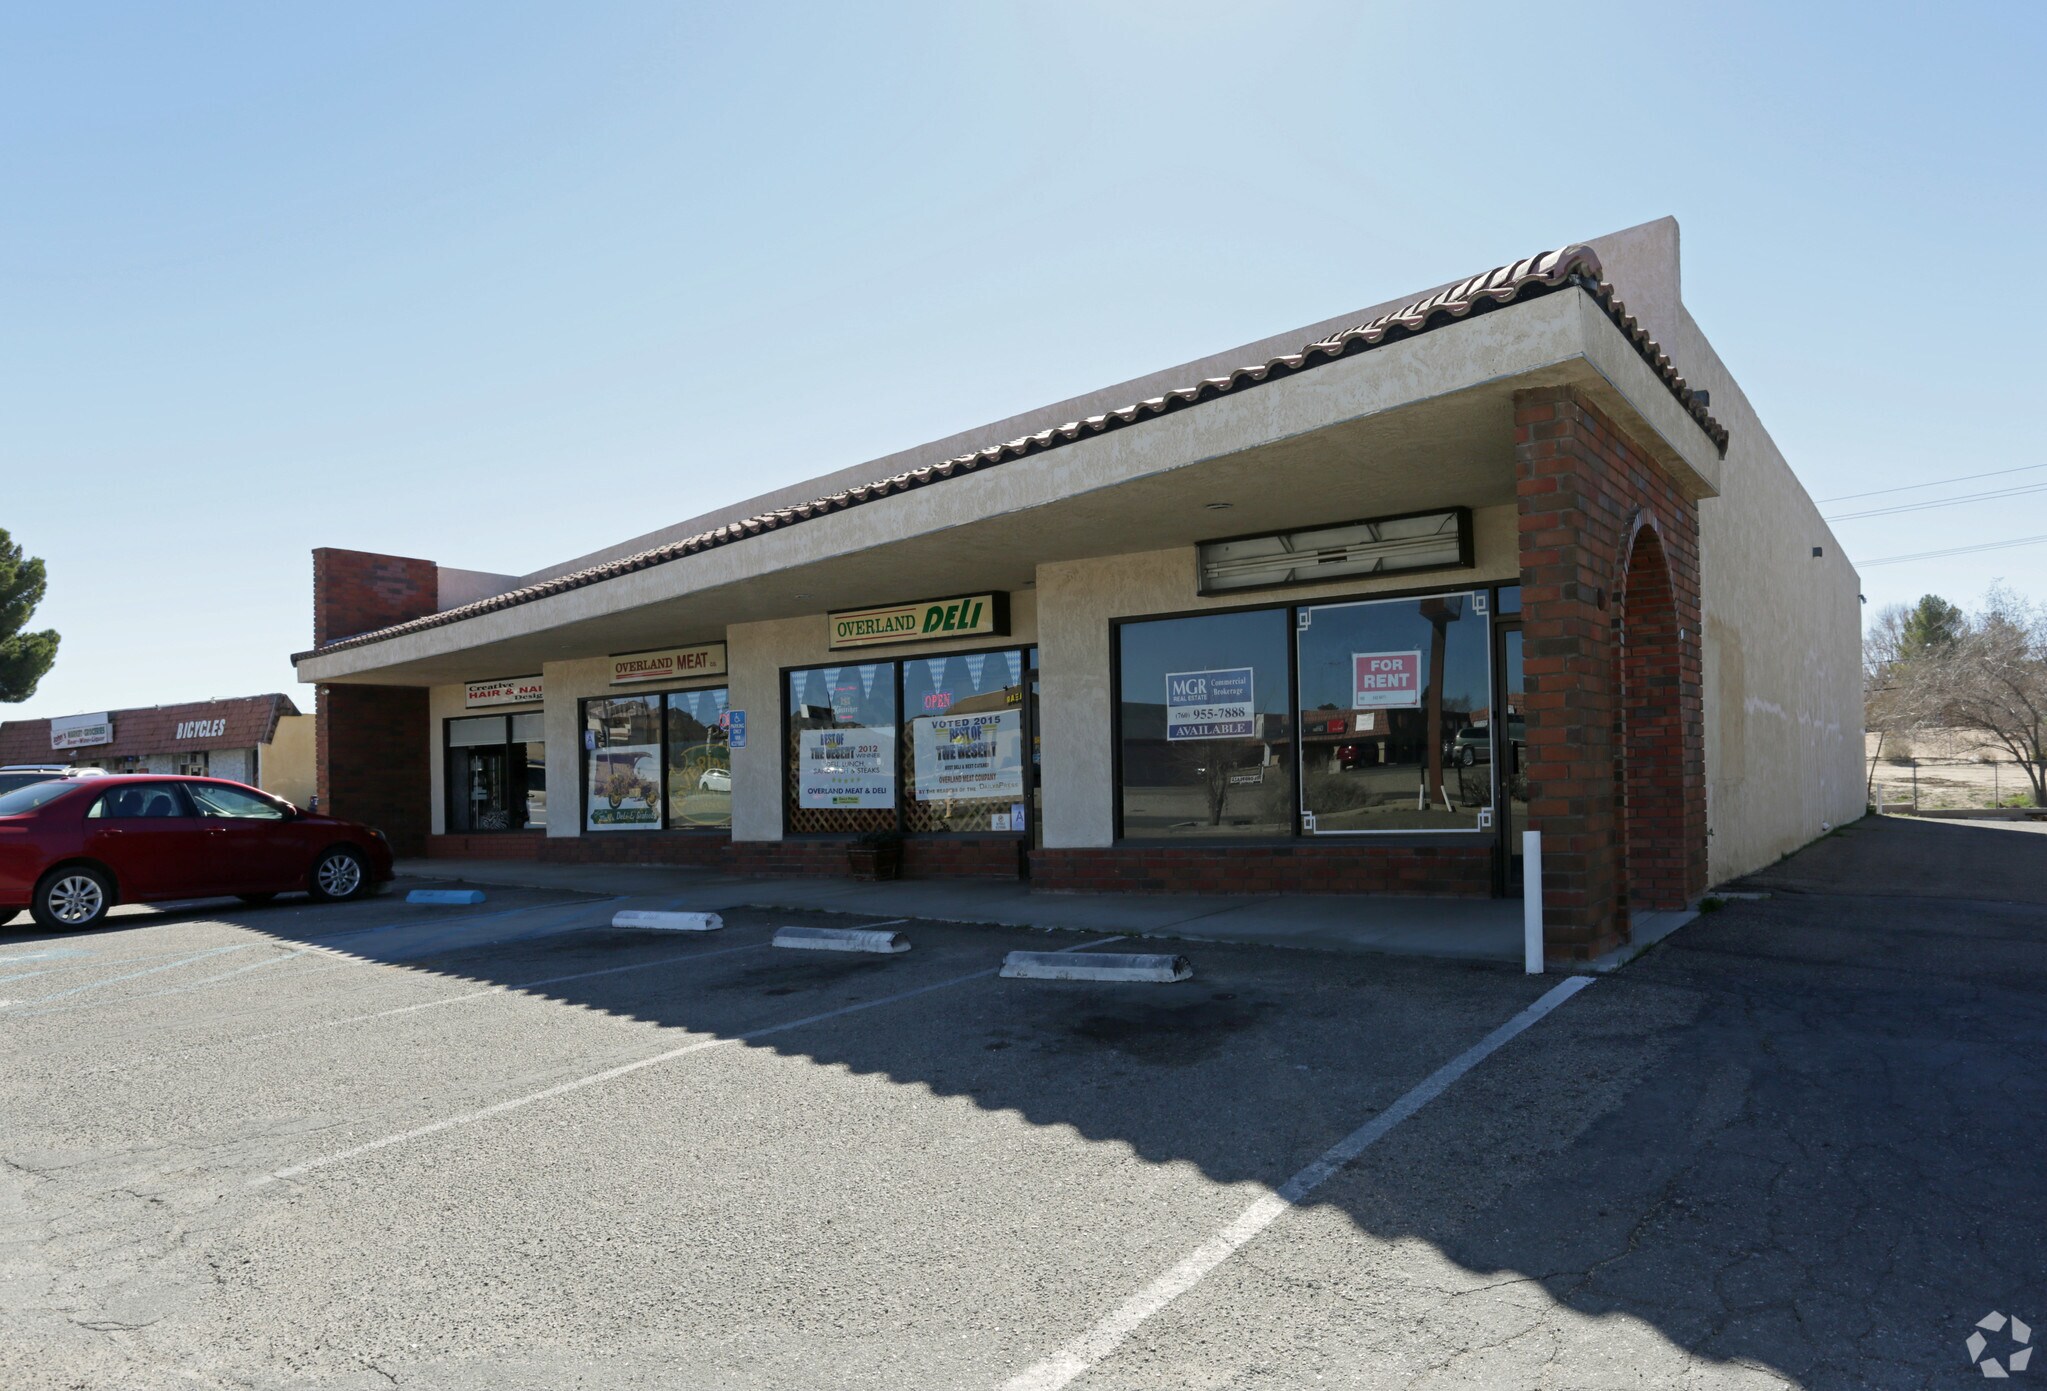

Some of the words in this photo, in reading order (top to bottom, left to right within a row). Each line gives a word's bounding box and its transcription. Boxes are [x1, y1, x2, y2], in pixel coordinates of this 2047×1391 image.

[837, 614, 916, 638] OVERLAND
[922, 599, 984, 634] DELI
[615, 657, 673, 673] OVERLAND
[677, 652, 708, 670] MEAT
[1371, 659, 1403, 671] FOR
[469, 682, 514, 691] Creative
[1173, 678, 1207, 696] MGR
[1211, 676, 1246, 686] Commercial
[1364, 673, 1410, 688] RENT
[469, 690, 501, 699] HAIR
[505, 688, 514, 696] &
[1213, 688, 1243, 696] Brokerage
[925, 693, 951, 709] OPEN
[1193, 707, 1245, 720] 955-7888
[931, 719, 969, 729] VOTED
[974, 715, 1001, 725] 2015
[176, 719, 226, 739] BICYCLES
[971, 725, 982, 741] OF
[1176, 723, 1246, 736] AVAILABLE
[836, 733, 844, 745] OF
[810, 747, 825, 760] THE
[858, 745, 878, 753] 2012
[935, 744, 956, 761] THE
[957, 741, 997, 760] DESERT
[939, 775, 962, 784] OVERLAND
[963, 774, 975, 783] MEAT
[975, 773, 996, 782] COMPANY
[1015, 811, 1024, 822] A
